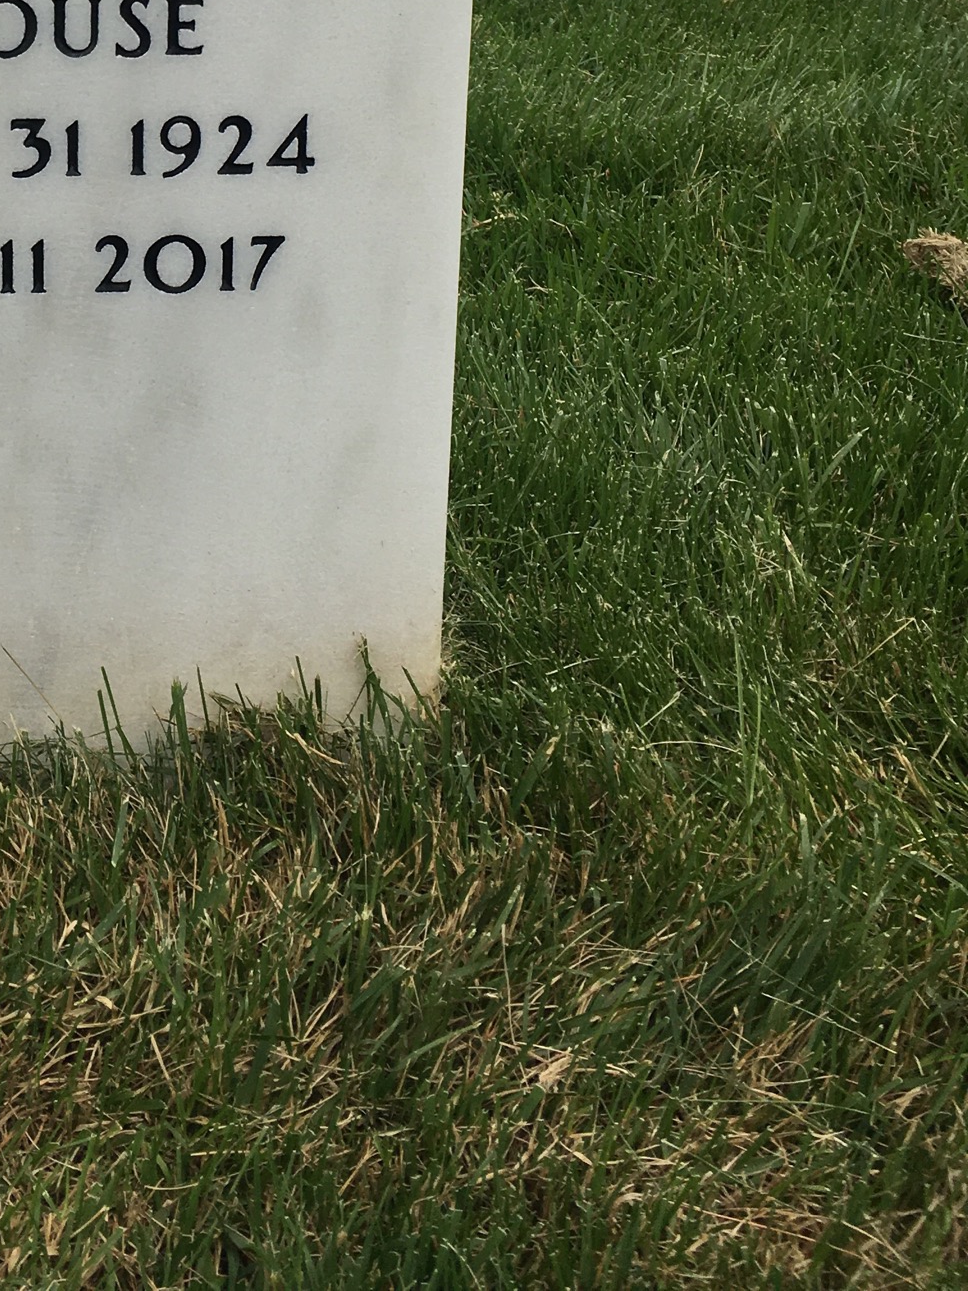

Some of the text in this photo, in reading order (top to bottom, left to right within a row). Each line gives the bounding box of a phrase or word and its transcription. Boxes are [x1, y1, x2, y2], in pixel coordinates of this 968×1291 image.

[10, 118, 82, 179] 31
[131, 114, 317, 179] 1924
[0, 240, 48, 295] 11
[95, 235, 287, 295] 2017
